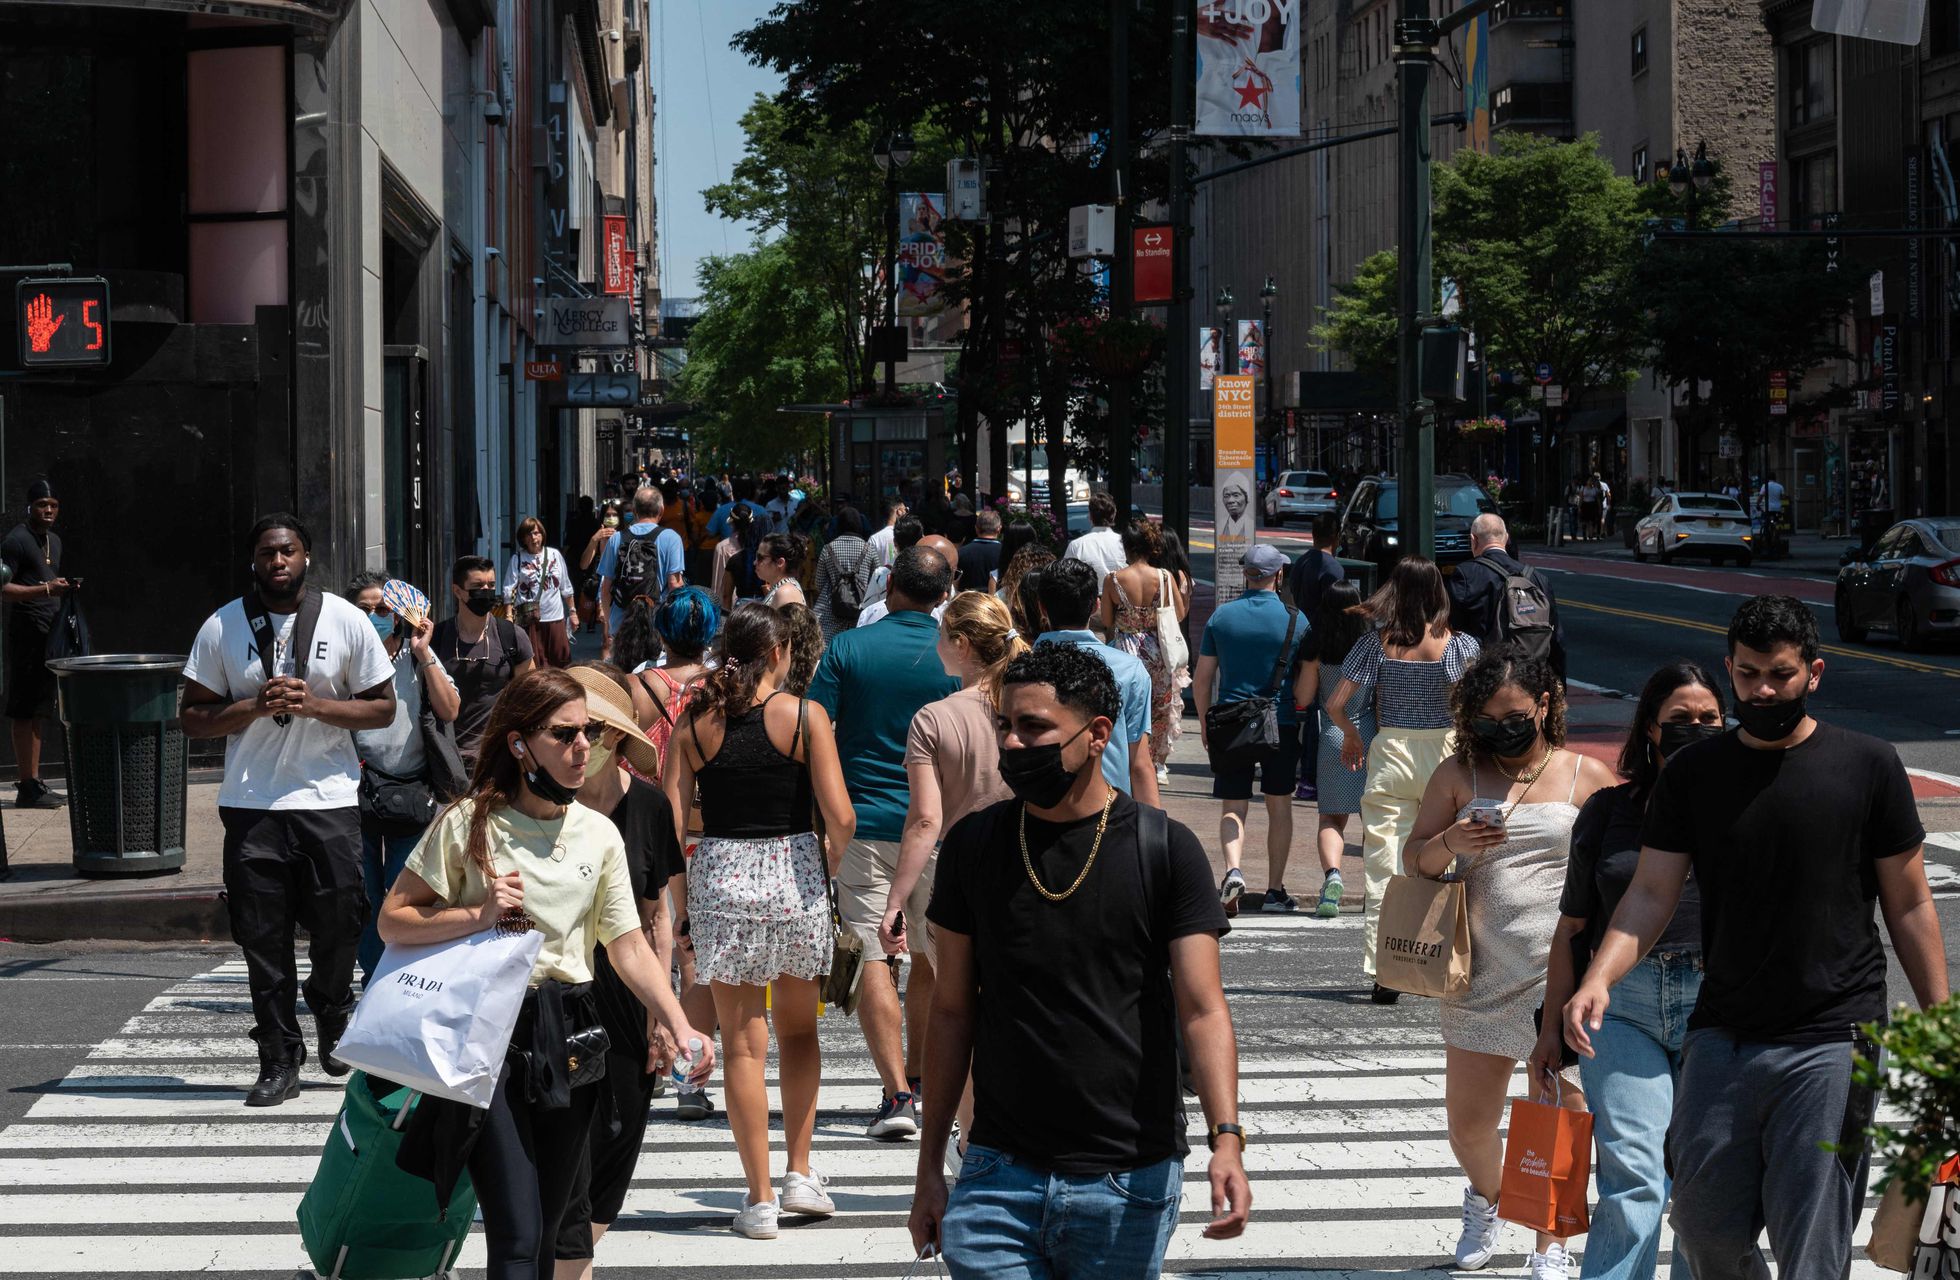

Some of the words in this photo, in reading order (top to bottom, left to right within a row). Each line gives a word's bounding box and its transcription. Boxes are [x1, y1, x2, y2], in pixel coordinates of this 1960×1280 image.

[1909, 157, 1918, 221] OUTFITTERS
[1763, 170, 1776, 228] SALON
[1145, 248, 1170, 257] Standing
[1909, 225, 1918, 263] EAGE
[609, 231, 622, 288] Superdry
[1909, 265, 1918, 320] AMERICAN
[83, 299, 103, 350] 5
[552, 308, 604, 327] MERCY
[558, 320, 618, 335] COLLEGE
[530, 363, 558, 375] ULTA
[1218, 379, 1251, 388] know
[1218, 391, 1251, 401] NYC
[1218, 410, 1251, 418] district
[1385, 936, 1428, 956] FOREVER
[1429, 944, 1443, 958] 21
[397, 972, 444, 992] PRADA
[403, 989, 424, 1000] MILANO
[1527, 1149, 1535, 1157] the
